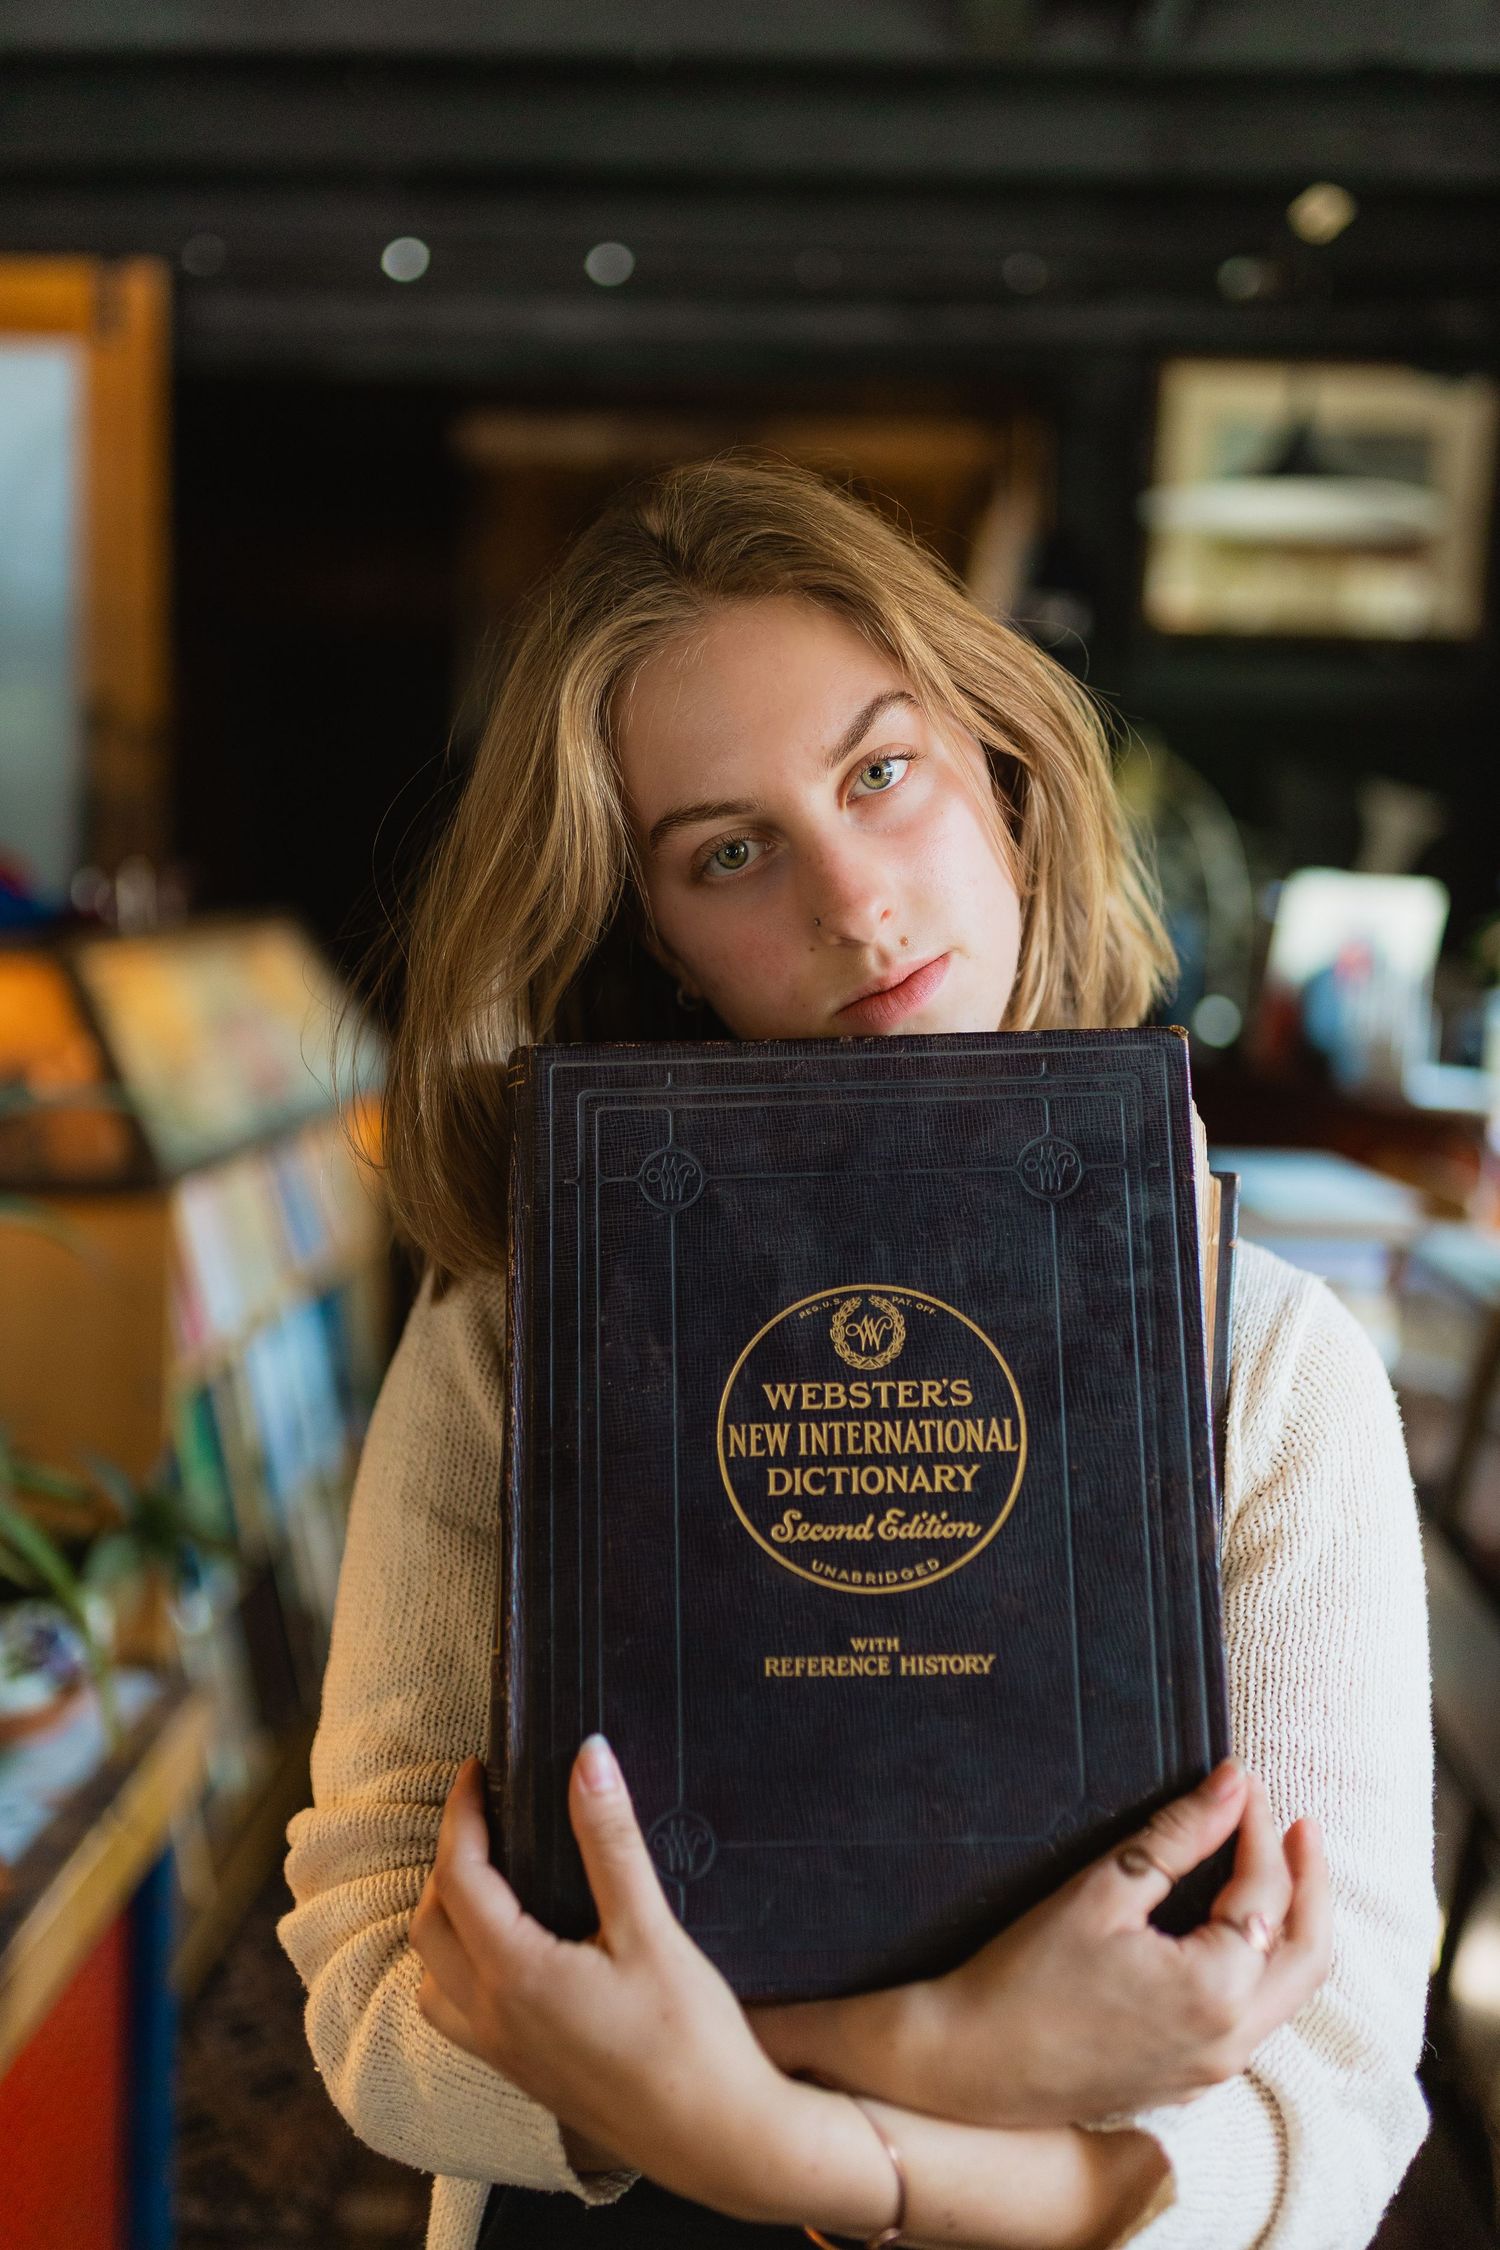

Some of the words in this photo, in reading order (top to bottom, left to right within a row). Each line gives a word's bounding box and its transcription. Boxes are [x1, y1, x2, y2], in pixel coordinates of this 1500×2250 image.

[762, 1379, 973, 1410] WEBSTER'S
[728, 1423, 791, 1457] NEW
[799, 1418, 1019, 1457] INTERNATIONAL
[767, 1464, 981, 1496] DICTIONARY
[771, 1509, 874, 1543] Second
[877, 1508, 982, 1541] Edition
[812, 1558, 940, 1585] UNABRIDGED
[850, 1638, 900, 1652] WITH
[765, 1657, 891, 1677] REFERENCE
[899, 1655, 996, 1676] HISTORY
